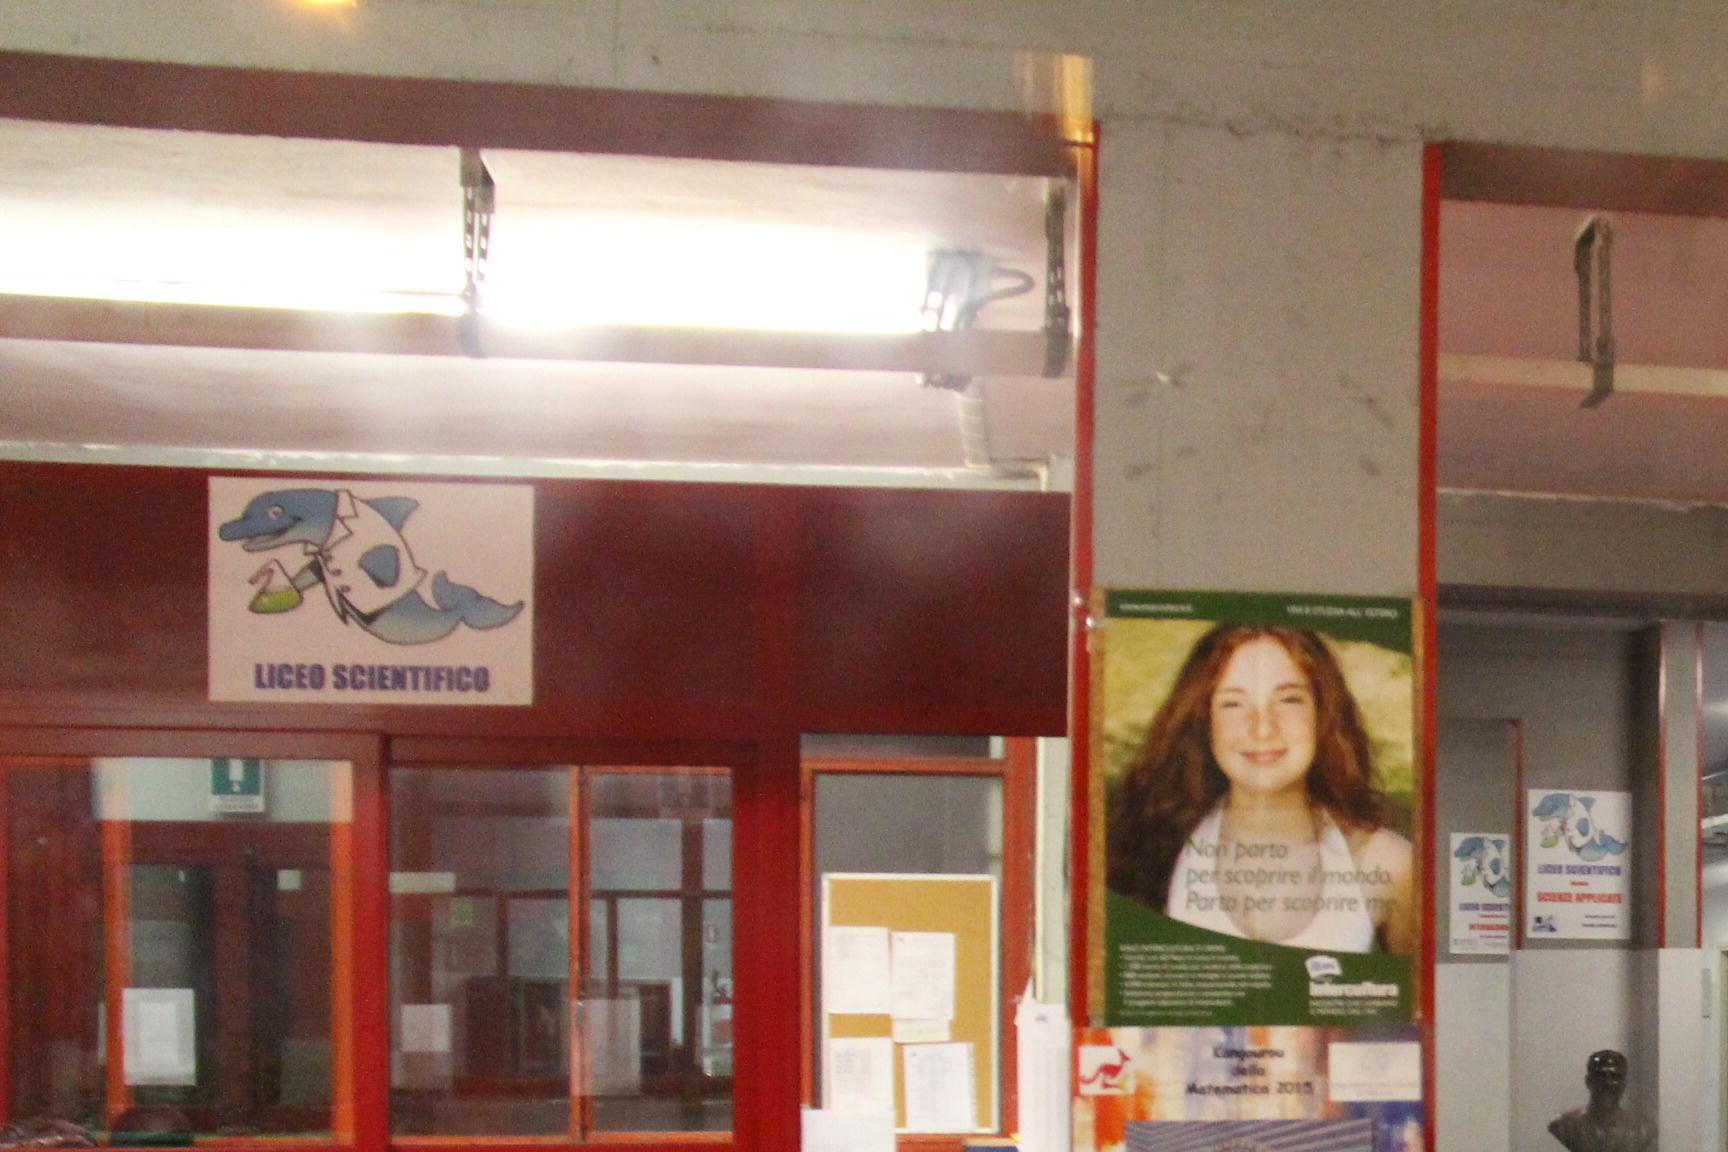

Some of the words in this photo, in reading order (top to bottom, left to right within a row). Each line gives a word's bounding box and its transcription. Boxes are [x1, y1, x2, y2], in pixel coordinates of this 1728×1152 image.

[255, 662, 325, 690] LICEO
[333, 664, 490, 693] SCIENTIFICO
[1186, 838, 1228, 858] Non
[1234, 841, 1288, 863] parto
[1186, 868, 1218, 889] per
[1225, 866, 1301, 890] scoprire
[1307, 866, 1319, 885] il
[1185, 891, 1238, 912] Parto
[1244, 897, 1273, 917] per
[1283, 894, 1358, 917] scoprire
[1213, 1047, 1284, 1061] Kangourou
[1230, 1064, 1265, 1077] della
[1185, 1082, 1269, 1096] Matematica
